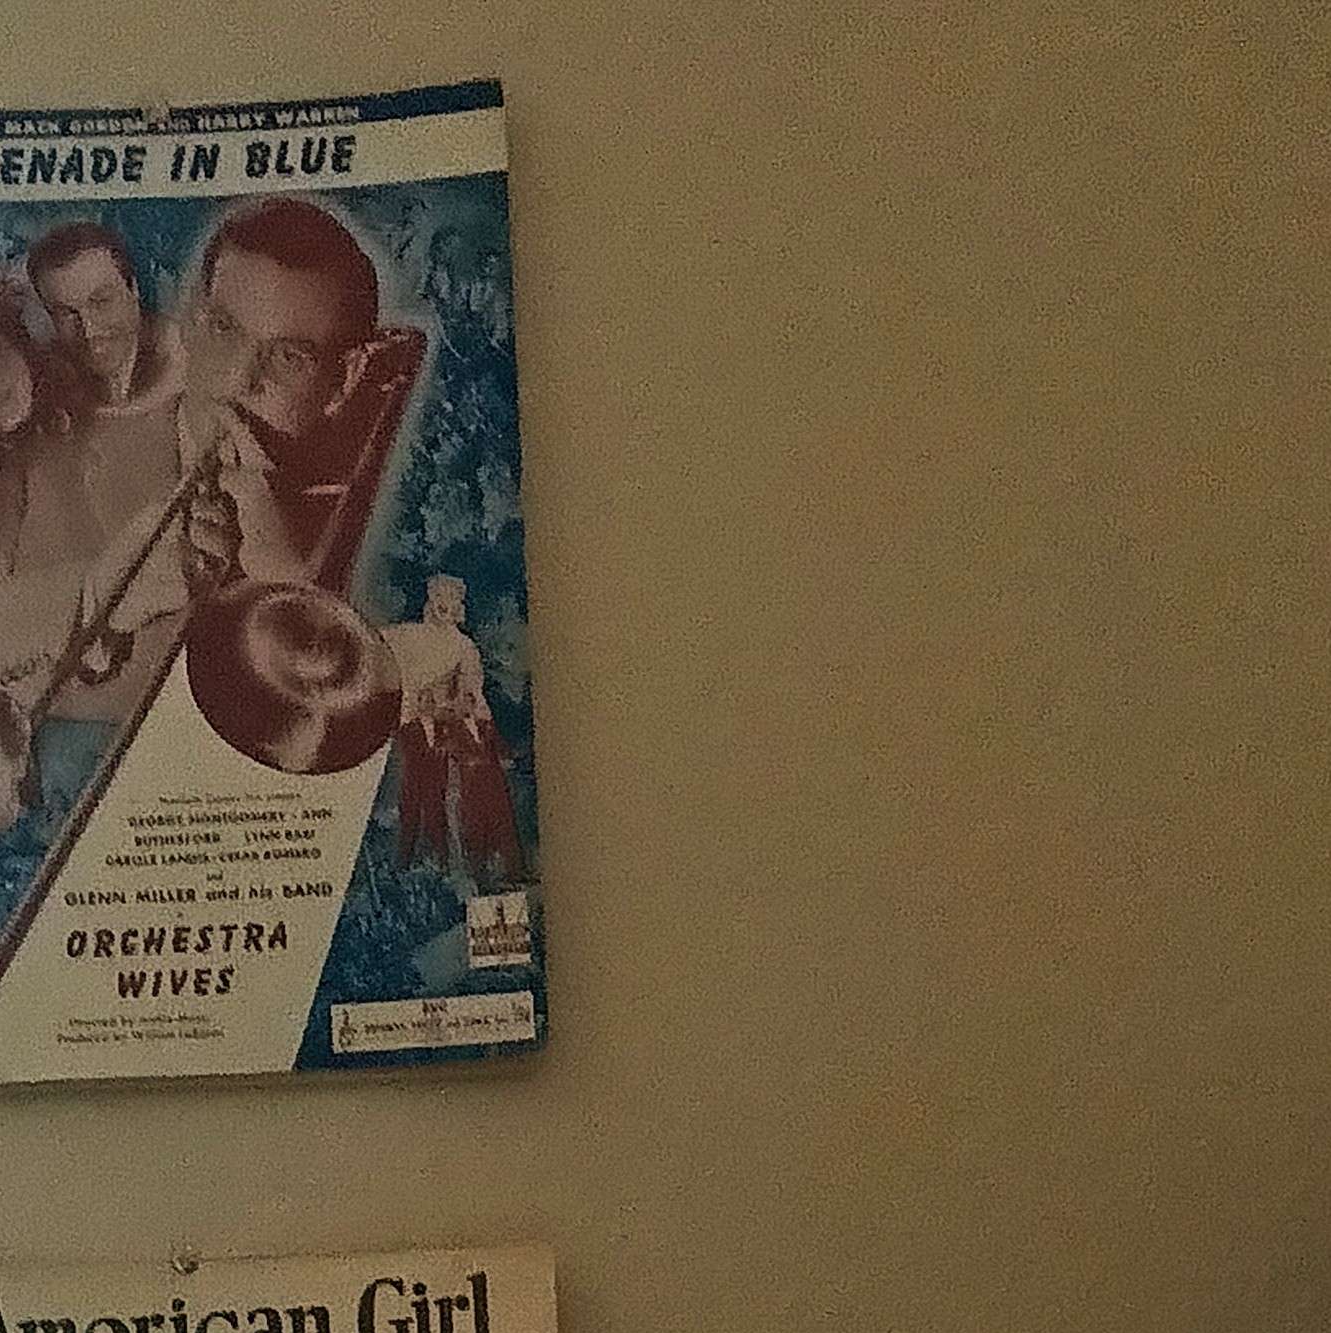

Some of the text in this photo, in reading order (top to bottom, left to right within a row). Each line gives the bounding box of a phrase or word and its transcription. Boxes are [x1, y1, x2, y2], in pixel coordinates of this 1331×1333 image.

[170, 141, 221, 182] IN
[244, 134, 358, 179] BLUE
[64, 881, 334, 907] GLENN MILLER and his BAND
[65, 920, 289, 959] ORCHESTRA
[117, 963, 236, 999] WIVES
